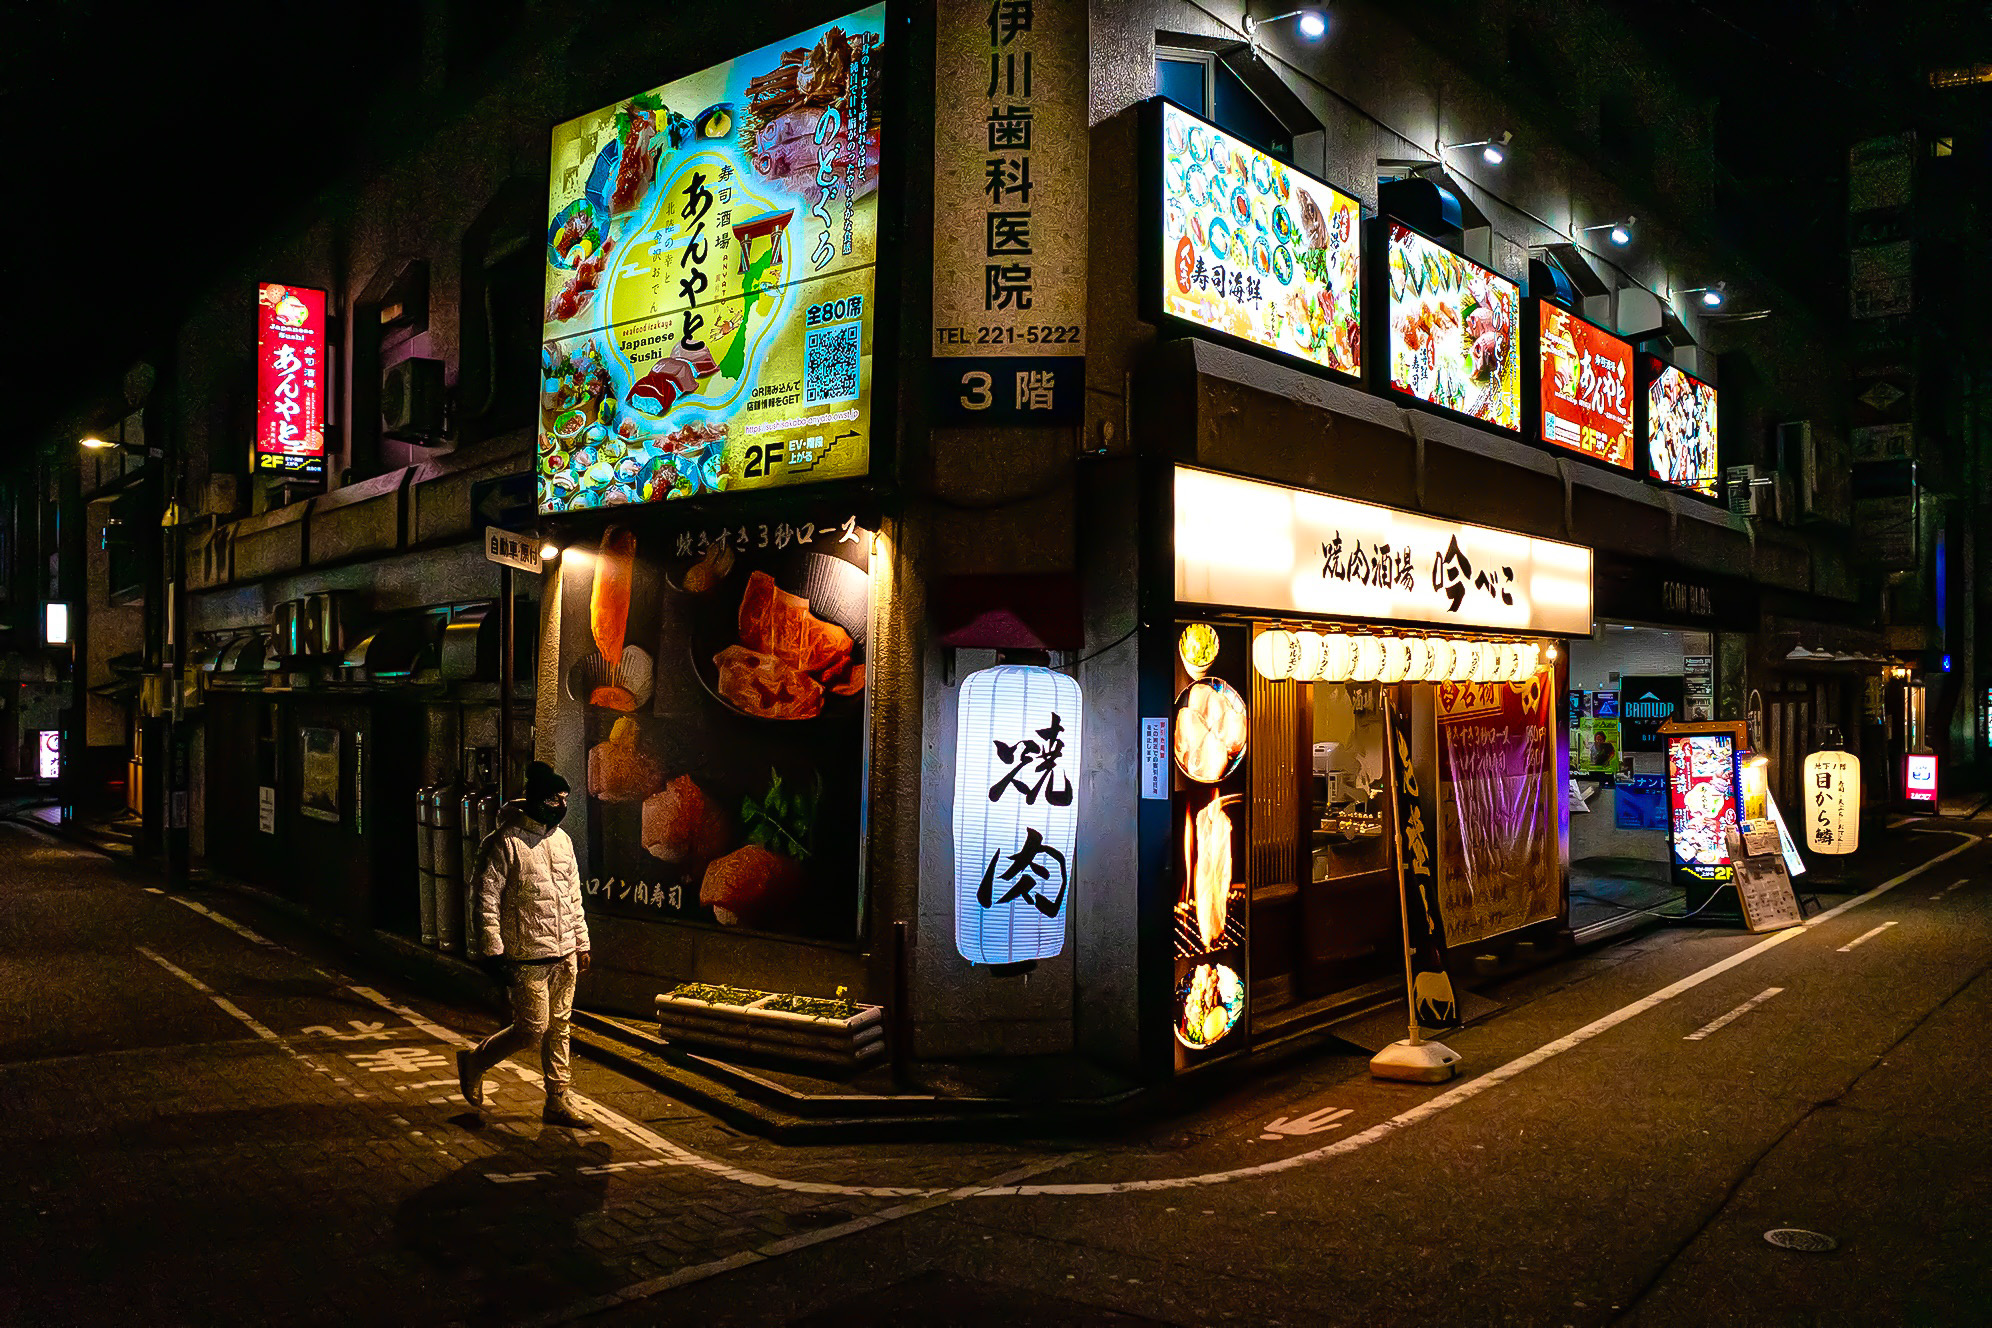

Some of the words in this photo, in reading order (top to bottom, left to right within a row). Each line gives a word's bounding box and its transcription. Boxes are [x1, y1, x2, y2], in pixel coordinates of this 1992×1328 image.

[984, 0, 1034, 312] 伊川歯科医院
[714, 164, 734, 250] 寿司酒場
[811, 104, 842, 272] のどぐろ
[678, 171, 715, 352] あんやと
[1190, 255, 1263, 311] 寿司海鮮
[806, 296, 863, 327] 全80席
[936, 327, 971, 345] TEL
[977, 326, 1081, 345] 221-5222
[619, 332, 675, 351] Japanese
[629, 348, 663, 364] Sushi
[273, 343, 302, 447] あんやと
[1579, 348, 1627, 416] あんやと
[260, 454, 284, 469] 2F
[743, 442, 785, 478] 2F
[1581, 425, 1597, 452] 2F
[1321, 530, 1415, 593] 焼肉酒場
[975, 711, 1074, 919] 焼肉
[582, 875, 683, 911] ロイン肉寿司
